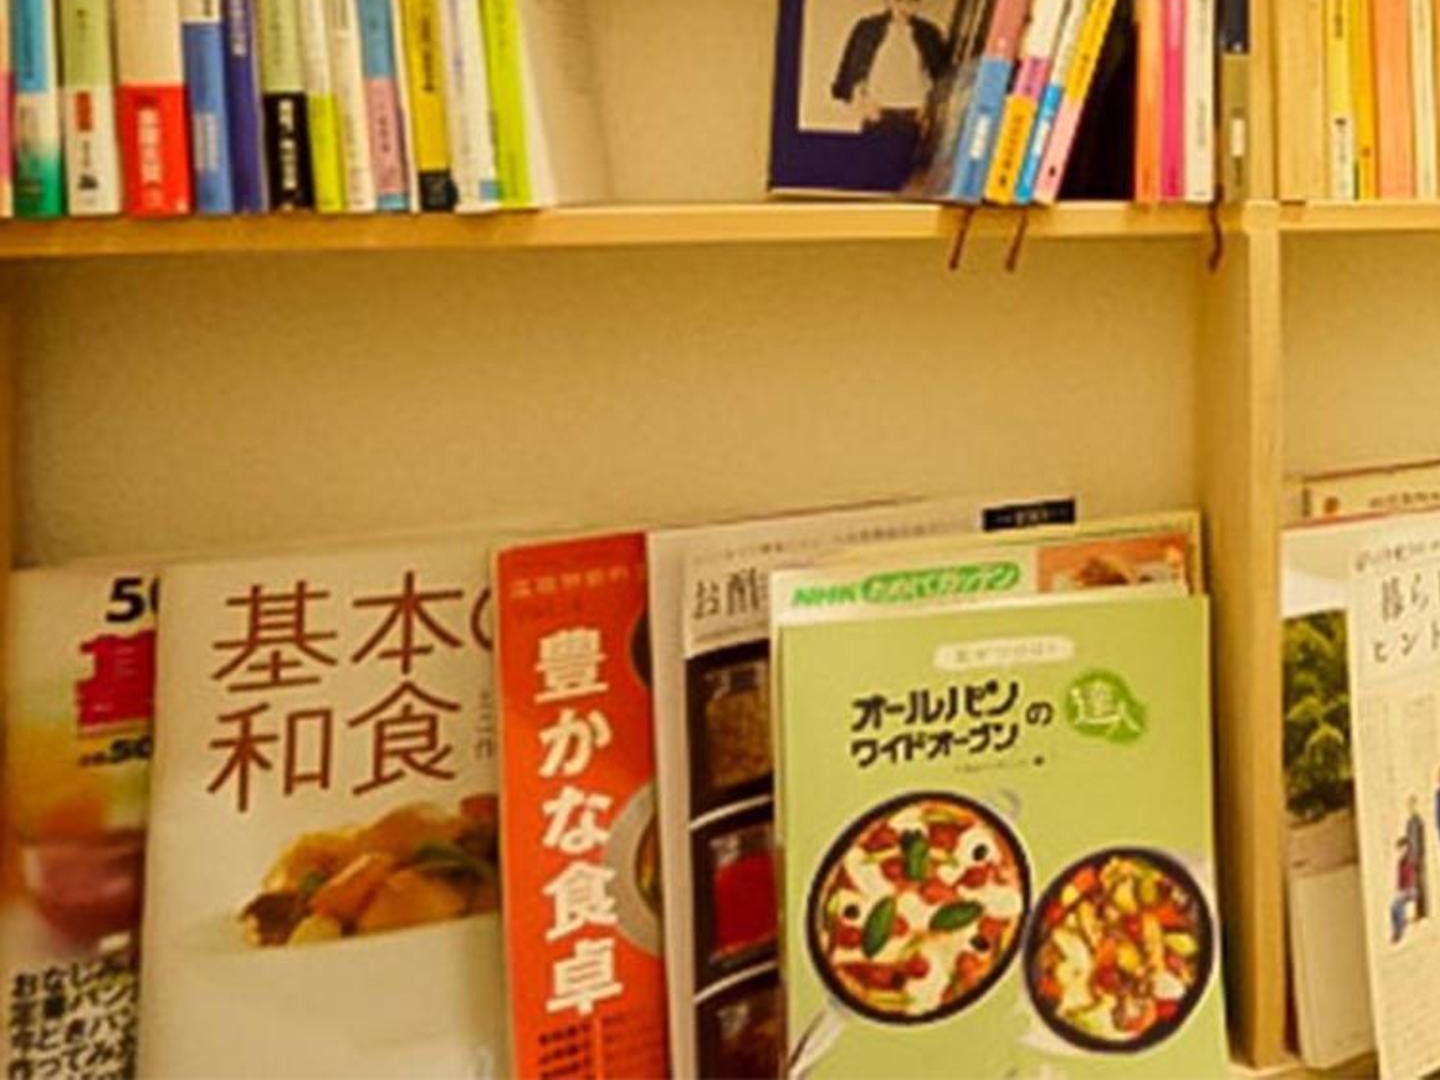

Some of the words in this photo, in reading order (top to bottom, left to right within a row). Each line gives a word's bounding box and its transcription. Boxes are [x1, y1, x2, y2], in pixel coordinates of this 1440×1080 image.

[206, 679, 464, 814] 和食
[1025, 701, 1054, 727] の
[533, 627, 624, 1016] 豊かな食卓
